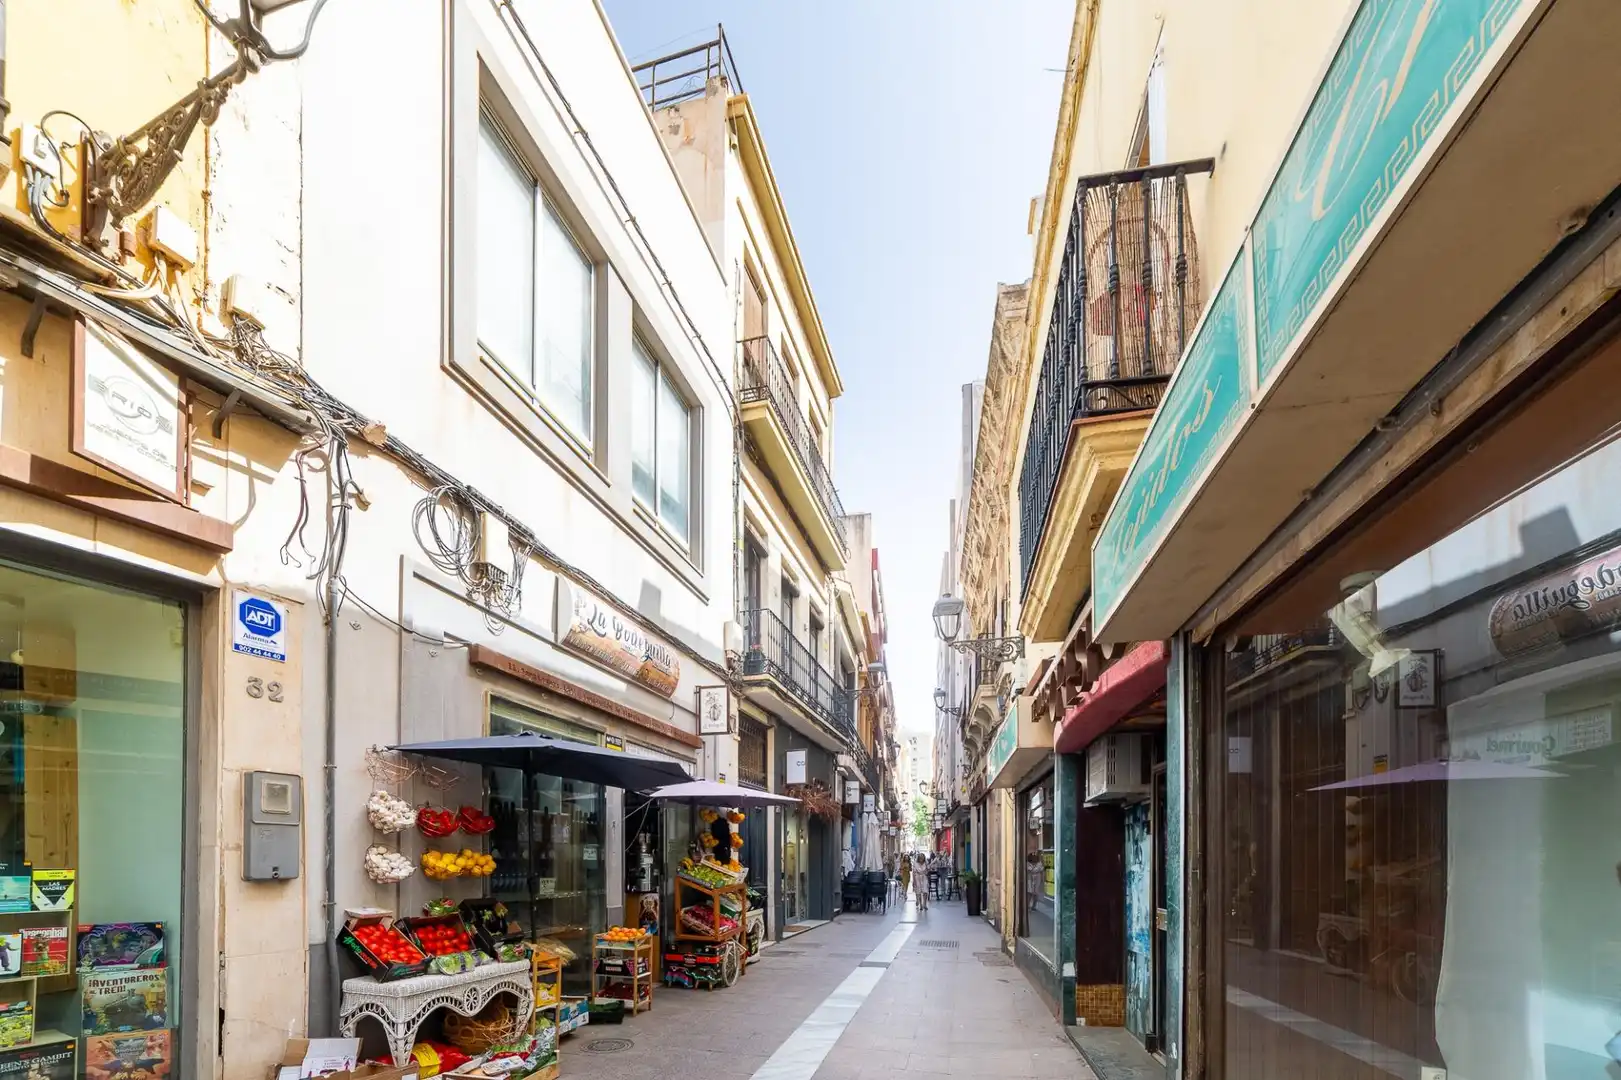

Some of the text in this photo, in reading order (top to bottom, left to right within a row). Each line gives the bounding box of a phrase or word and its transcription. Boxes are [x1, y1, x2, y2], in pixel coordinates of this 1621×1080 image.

[1112, 375, 1222, 578] Tejidos
[246, 609, 275, 628] ADT
[586, 603, 607, 638] La
[246, 675, 284, 704] 32
[32, 1051, 73, 1064] GAMBIT
